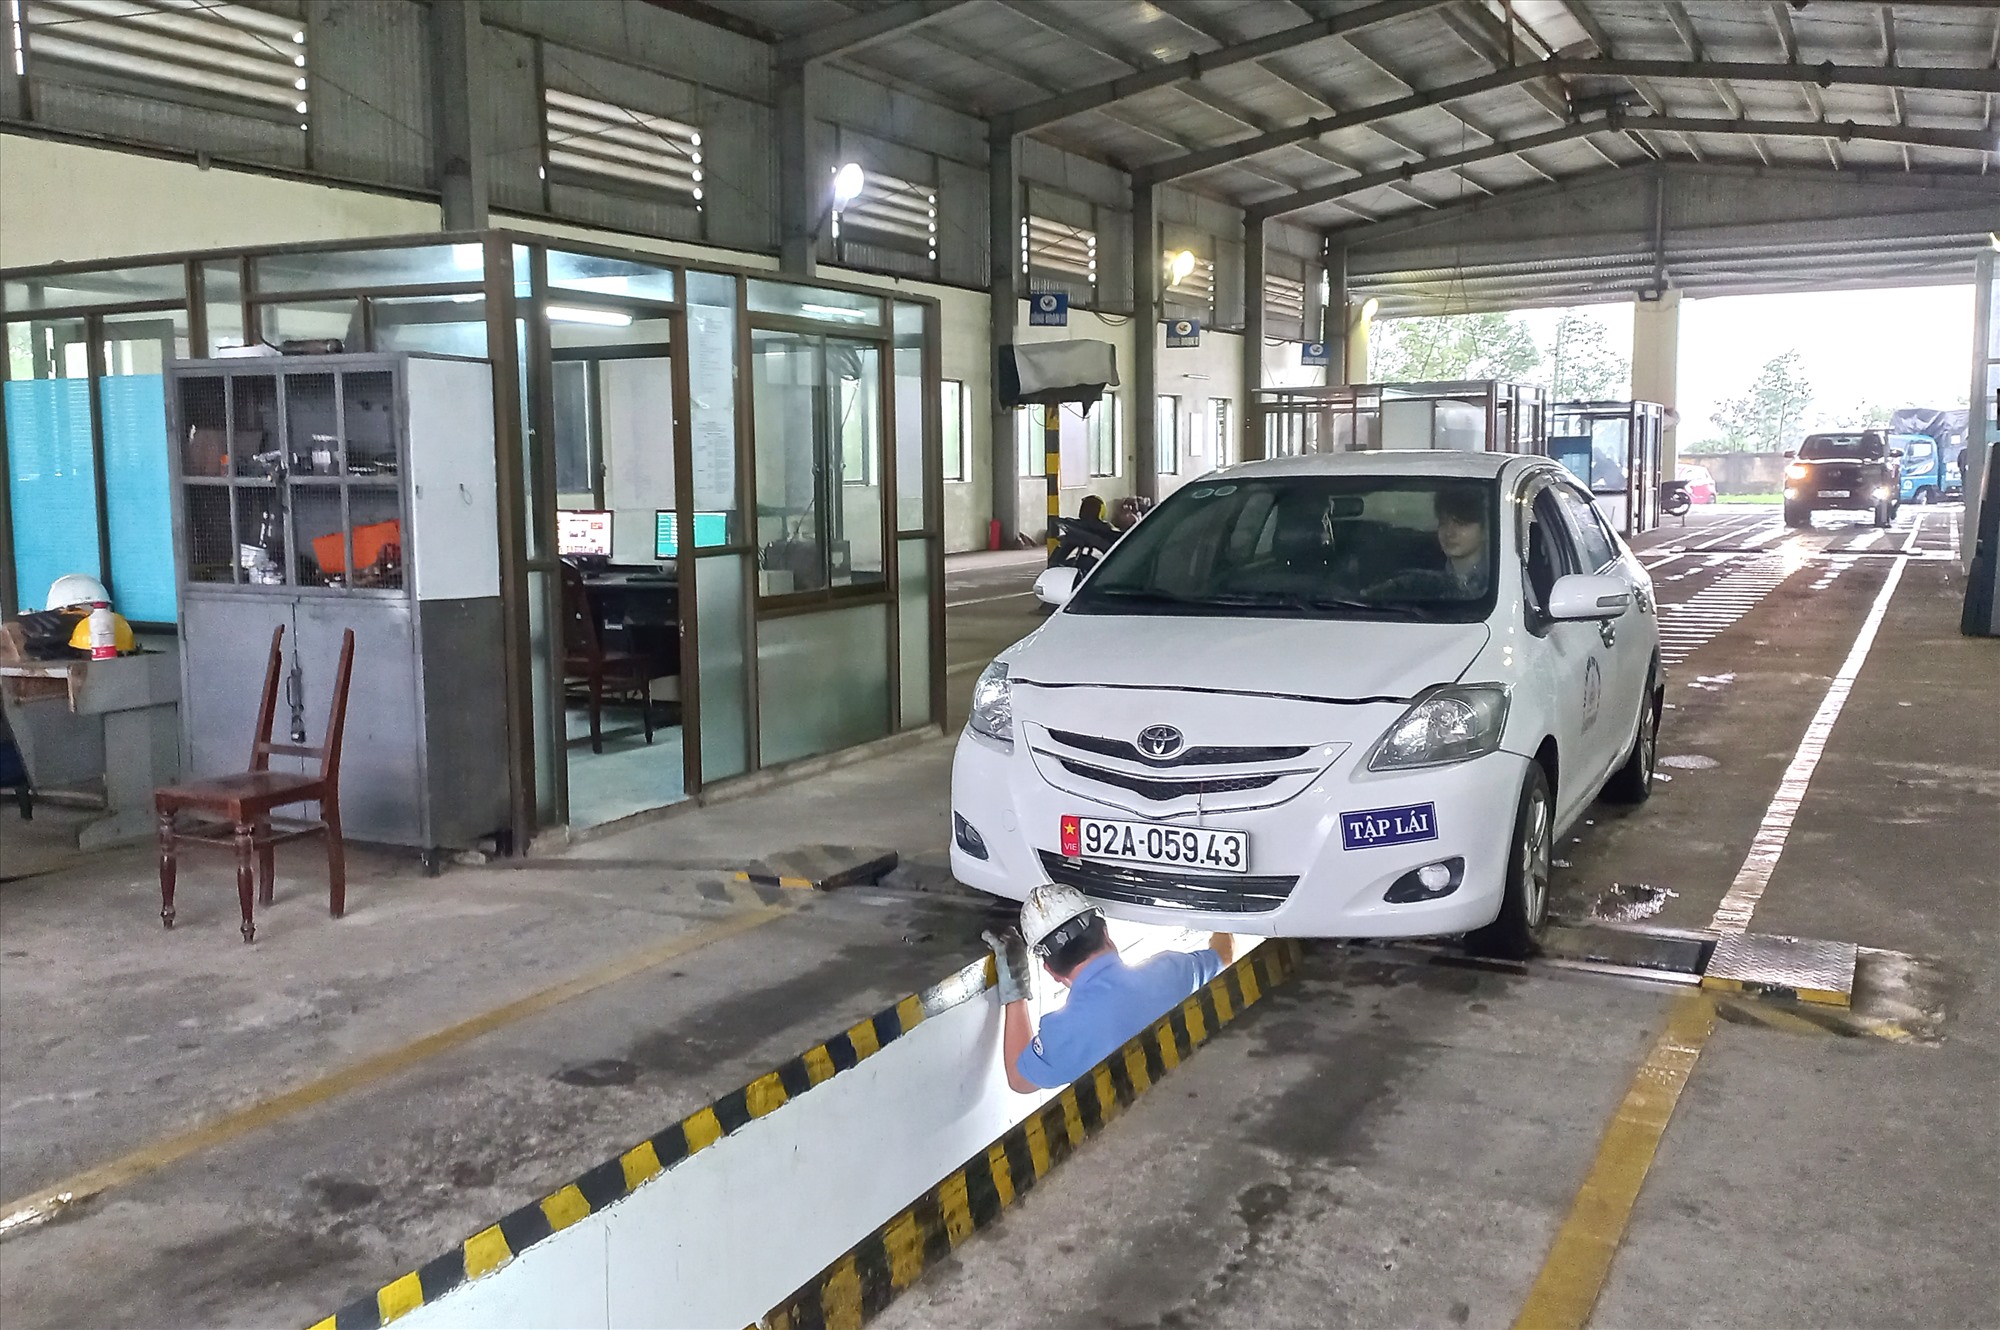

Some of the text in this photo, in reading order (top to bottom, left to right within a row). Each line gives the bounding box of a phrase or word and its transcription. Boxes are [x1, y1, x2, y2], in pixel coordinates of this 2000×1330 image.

[1350, 810, 1429, 843] TẬP LÁI
[1064, 842, 1077, 851] VIE
[1085, 823, 1241, 868] 92A-059.43
